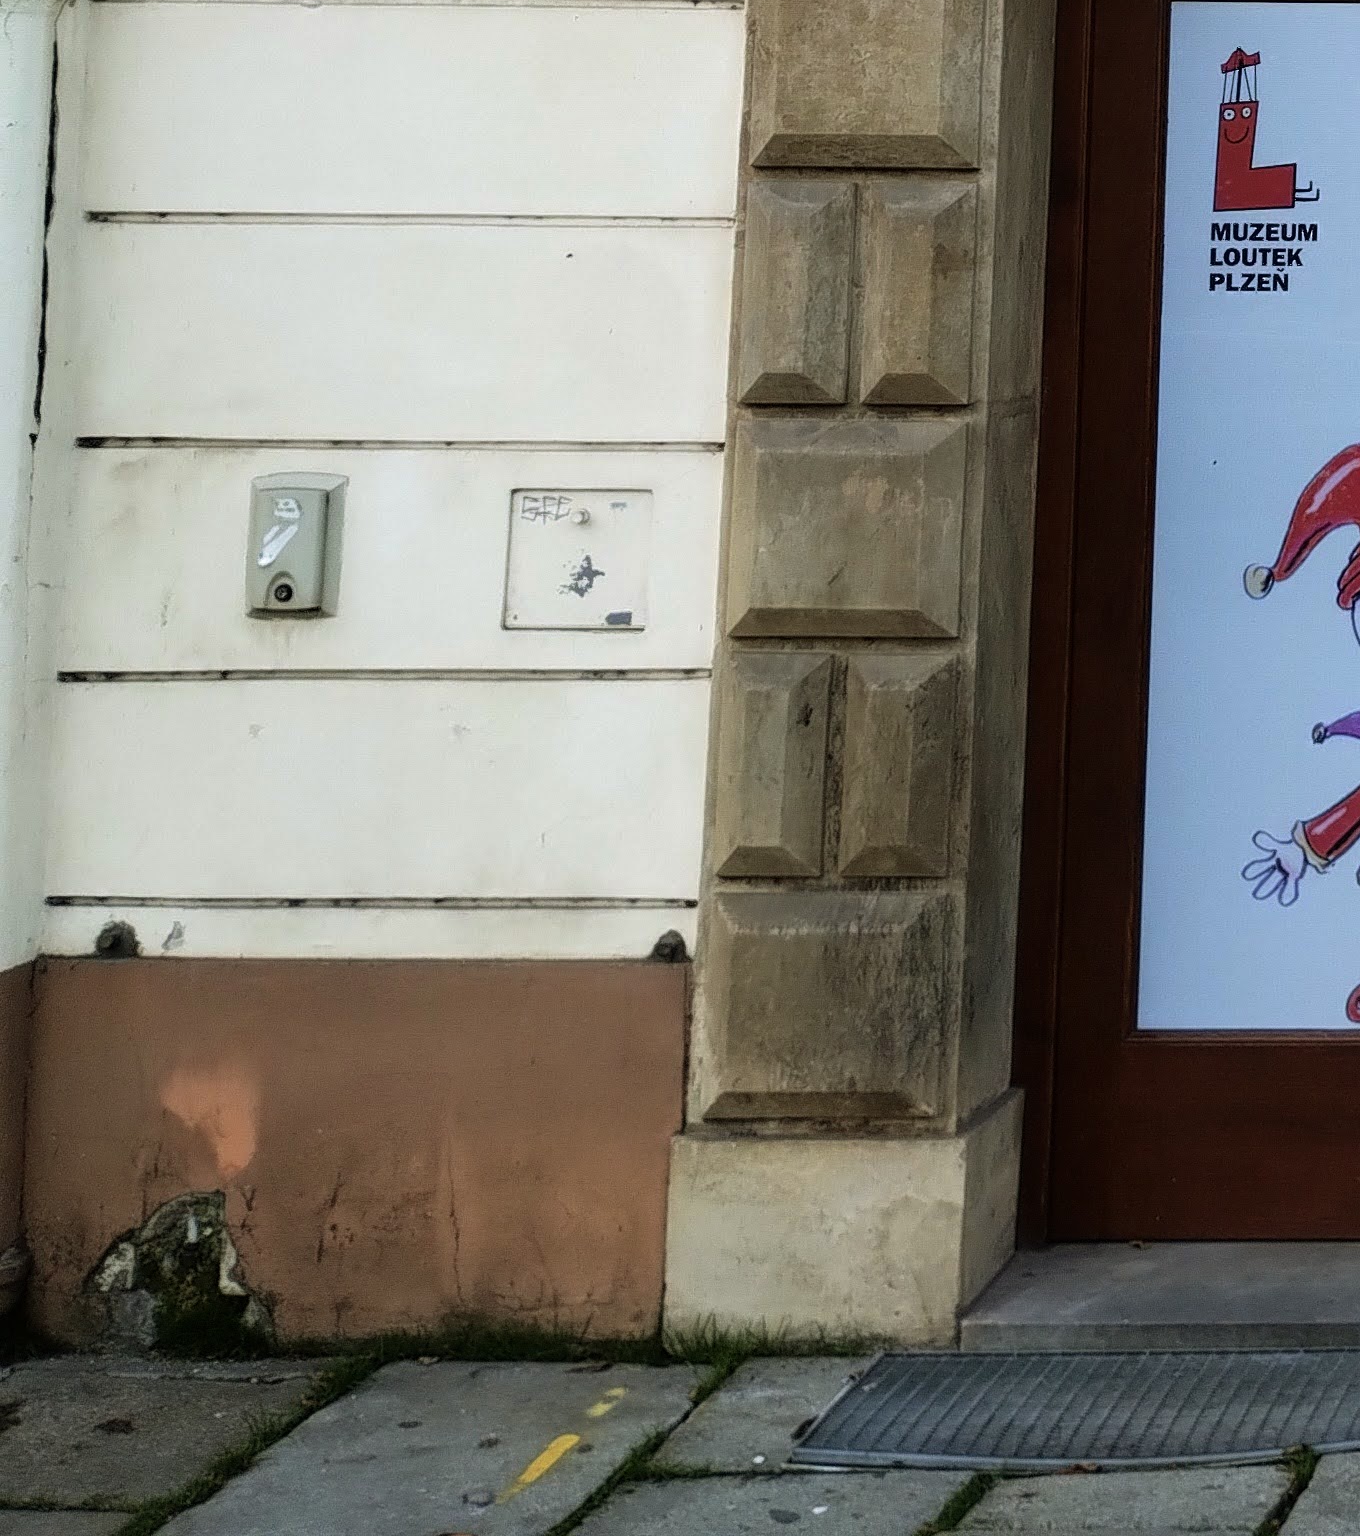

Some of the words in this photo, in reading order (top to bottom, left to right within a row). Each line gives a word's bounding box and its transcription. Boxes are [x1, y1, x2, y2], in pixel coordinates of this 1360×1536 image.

[1210, 222, 1318, 241] MUZEUM
[1209, 248, 1303, 266] LOUTEK
[1209, 268, 1288, 291] PLZEŇ
